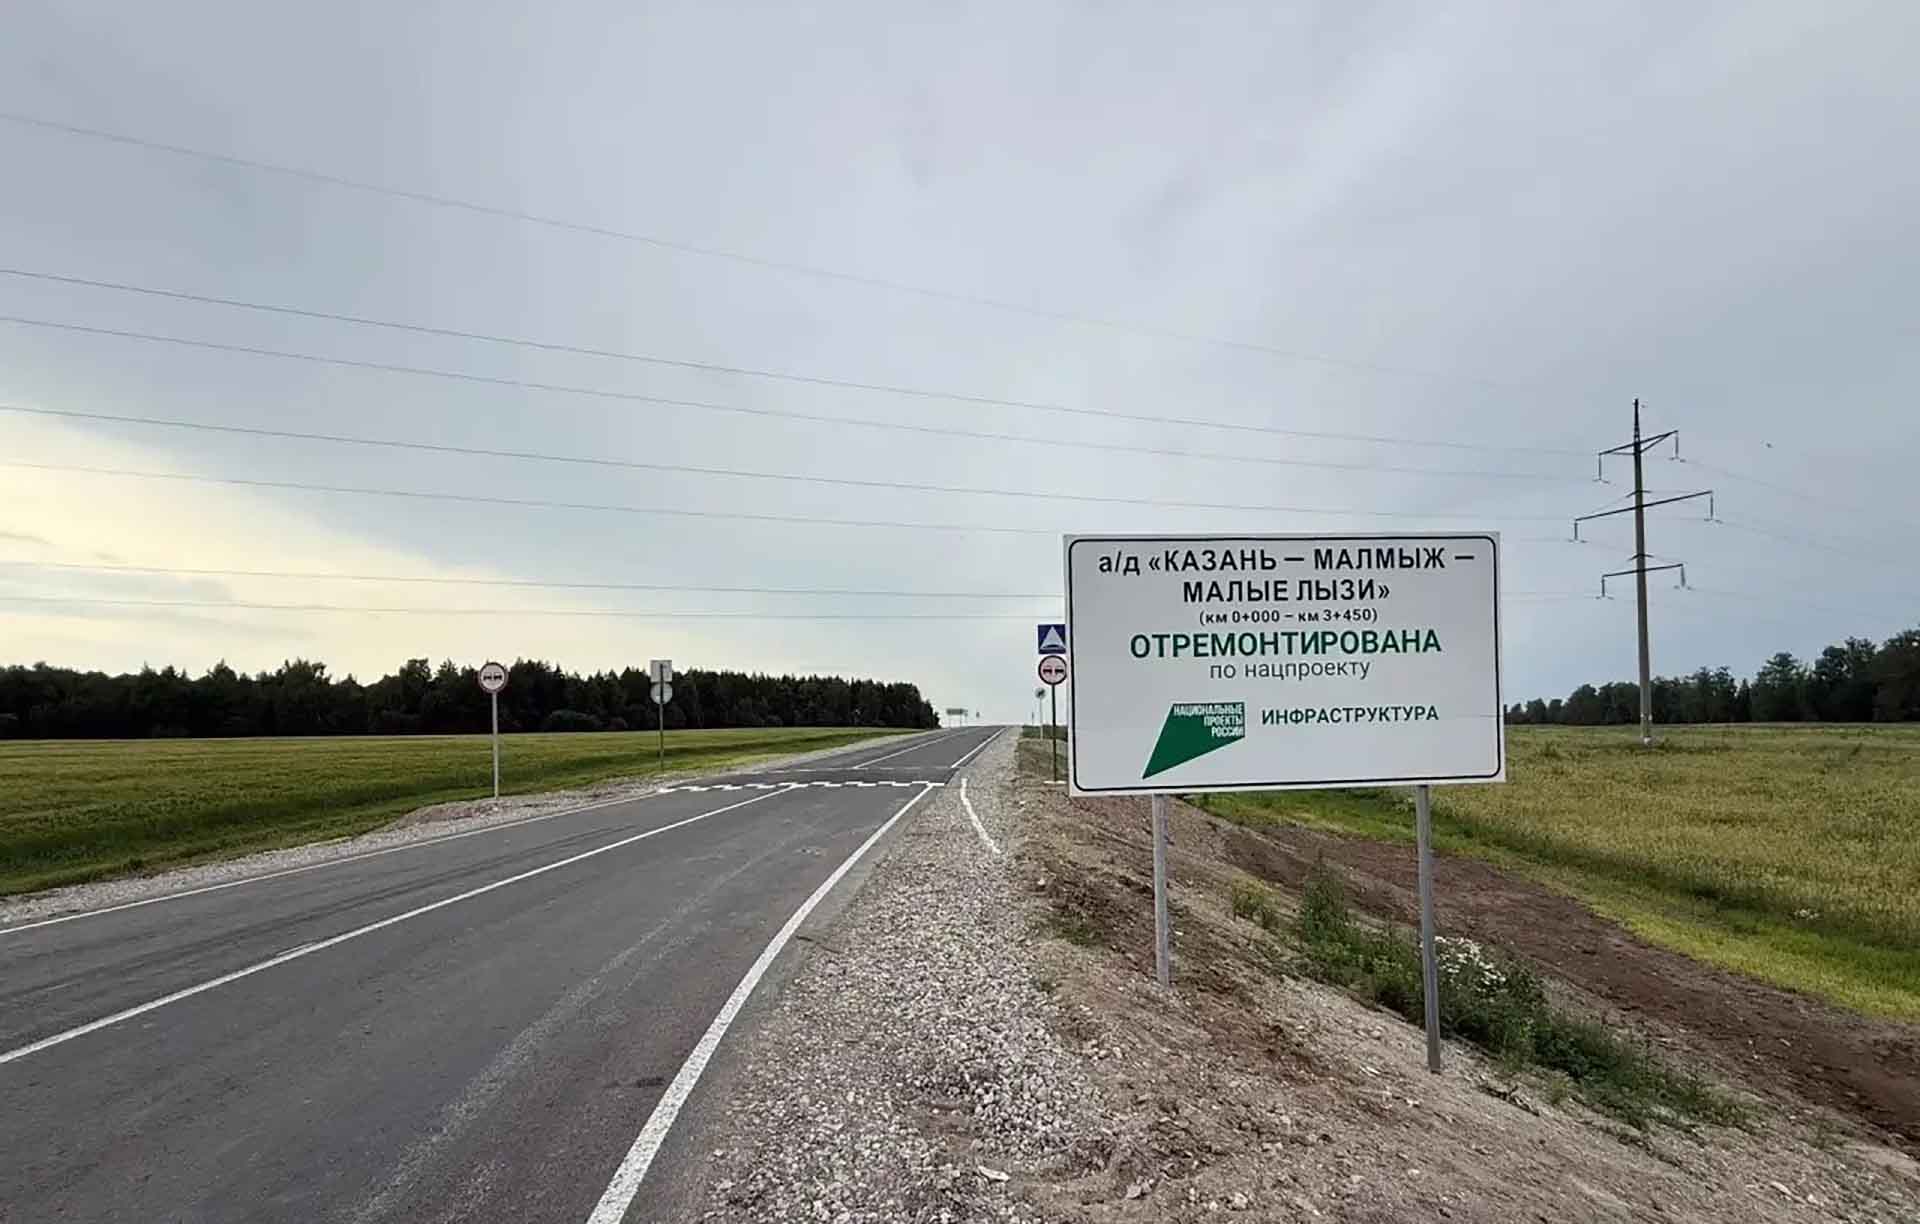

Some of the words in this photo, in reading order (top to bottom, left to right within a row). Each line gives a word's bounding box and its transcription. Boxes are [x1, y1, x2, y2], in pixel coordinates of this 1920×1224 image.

[1098, 551, 1140, 576] а/д
[1148, 549, 1277, 571] «КАЗАНЬ
[1313, 547, 1446, 570] МАЛМЫЖ
[1183, 580, 1289, 603] МАЛЫЕ
[1295, 578, 1391, 602] ЛЫЗИ»
[1199, 610, 1227, 626] (км
[1231, 610, 1280, 623] 0+000
[1298, 611, 1319, 622] км
[1323, 608, 1378, 624] 3+450)
[1130, 629, 1442, 658] ОТРЕМОНТИРОВАНА
[1210, 663, 1236, 679] по
[1244, 661, 1371, 681] нацпроекту
[1173, 703, 1243, 716] НАЦИОНАЛЬНЫЕ
[1261, 705, 1440, 725] ИНФРАСТРУКТУРА
[1203, 714, 1243, 726] ПРОЕКТЫ
